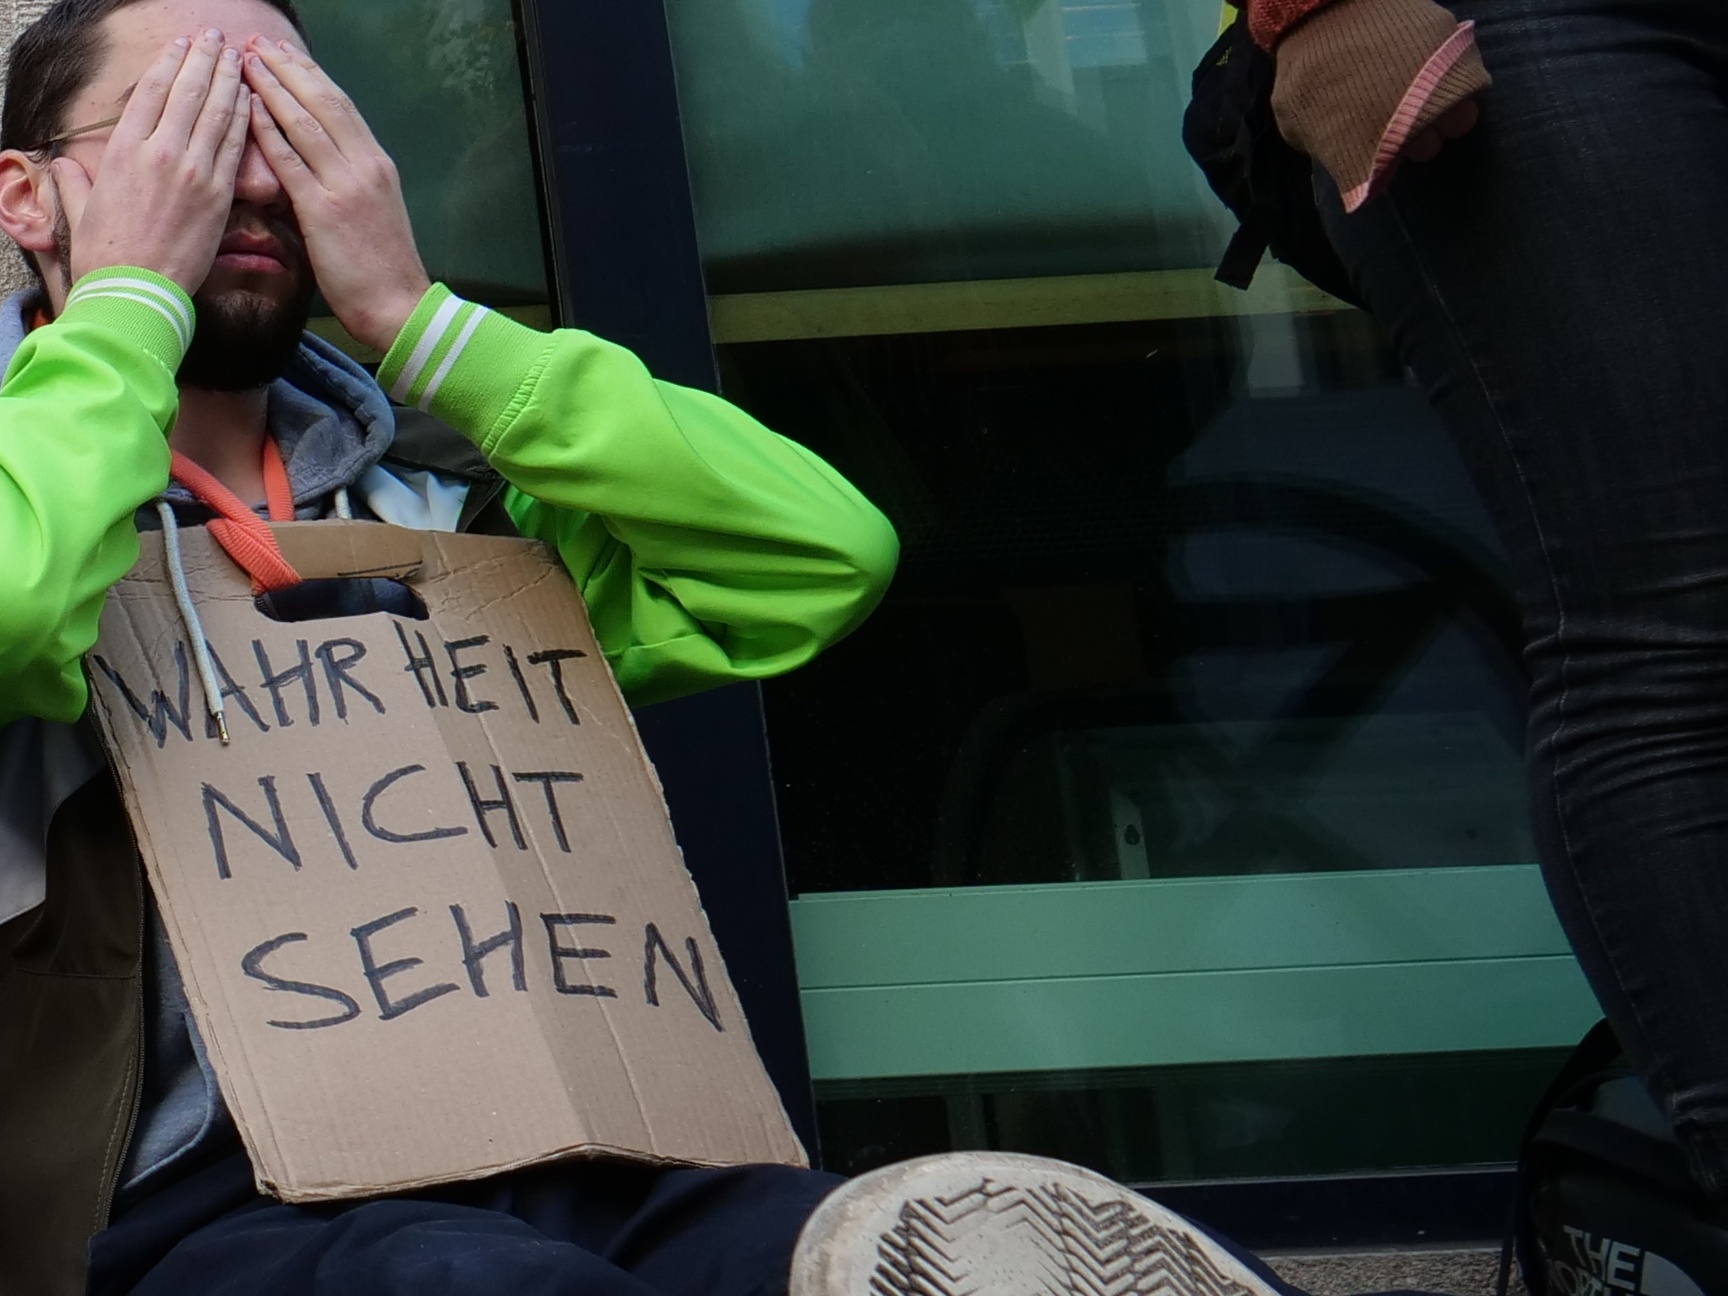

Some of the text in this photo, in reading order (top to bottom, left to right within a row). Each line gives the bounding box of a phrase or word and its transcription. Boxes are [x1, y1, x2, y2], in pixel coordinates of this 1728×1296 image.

[201, 759, 584, 880] NICHT
[242, 900, 726, 1033] SEHEN
[1563, 1223, 1642, 1291] THE
